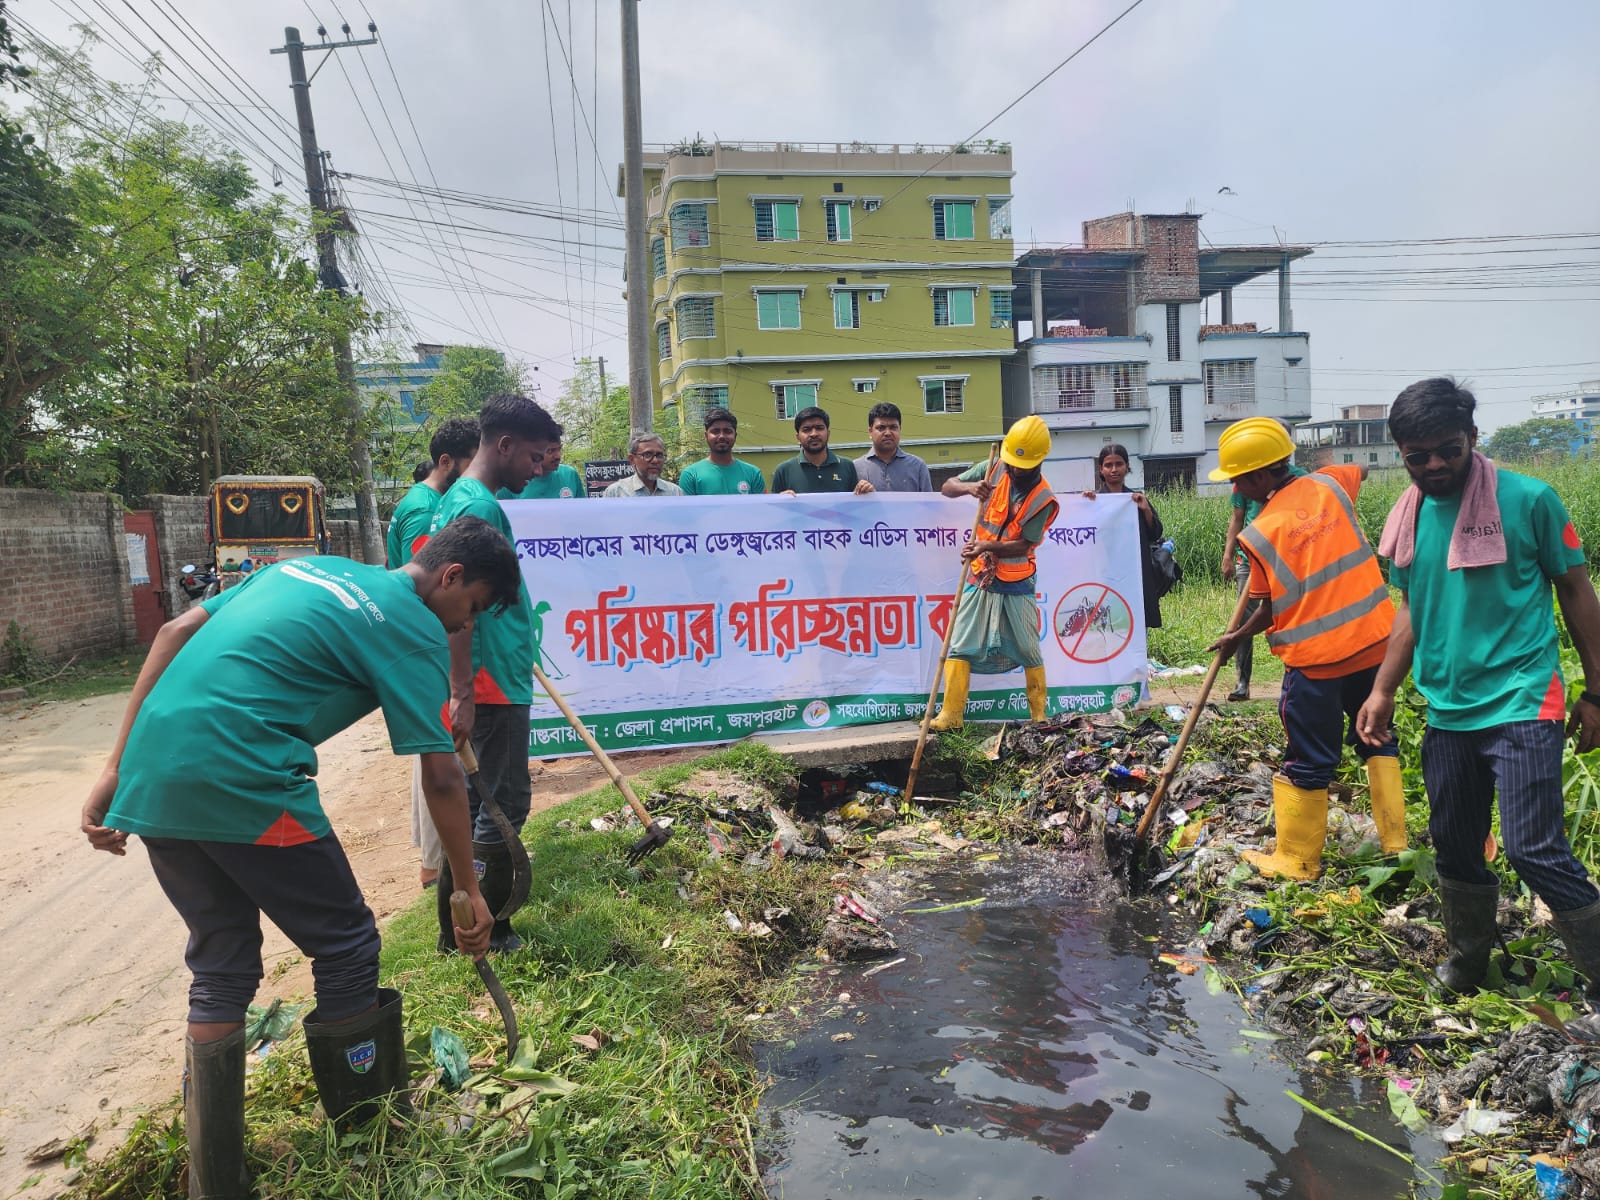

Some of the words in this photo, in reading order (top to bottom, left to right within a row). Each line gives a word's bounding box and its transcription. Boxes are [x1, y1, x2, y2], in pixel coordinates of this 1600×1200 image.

[515, 534, 623, 560] স্বেচ্ছাশ্রমের
[630, 533, 698, 555] মাধ্যমে
[705, 530, 797, 558] ডেঙ্গুজ্বরের
[803, 528, 852, 550] বাহক
[859, 521, 909, 548] এডিস
[914, 526, 958, 548] মশার
[728, 578, 921, 663] পরিচ্ছন্নতা
[615, 718, 656, 738] জেলা
[727, 704, 799, 728] জয়পুরহাট
